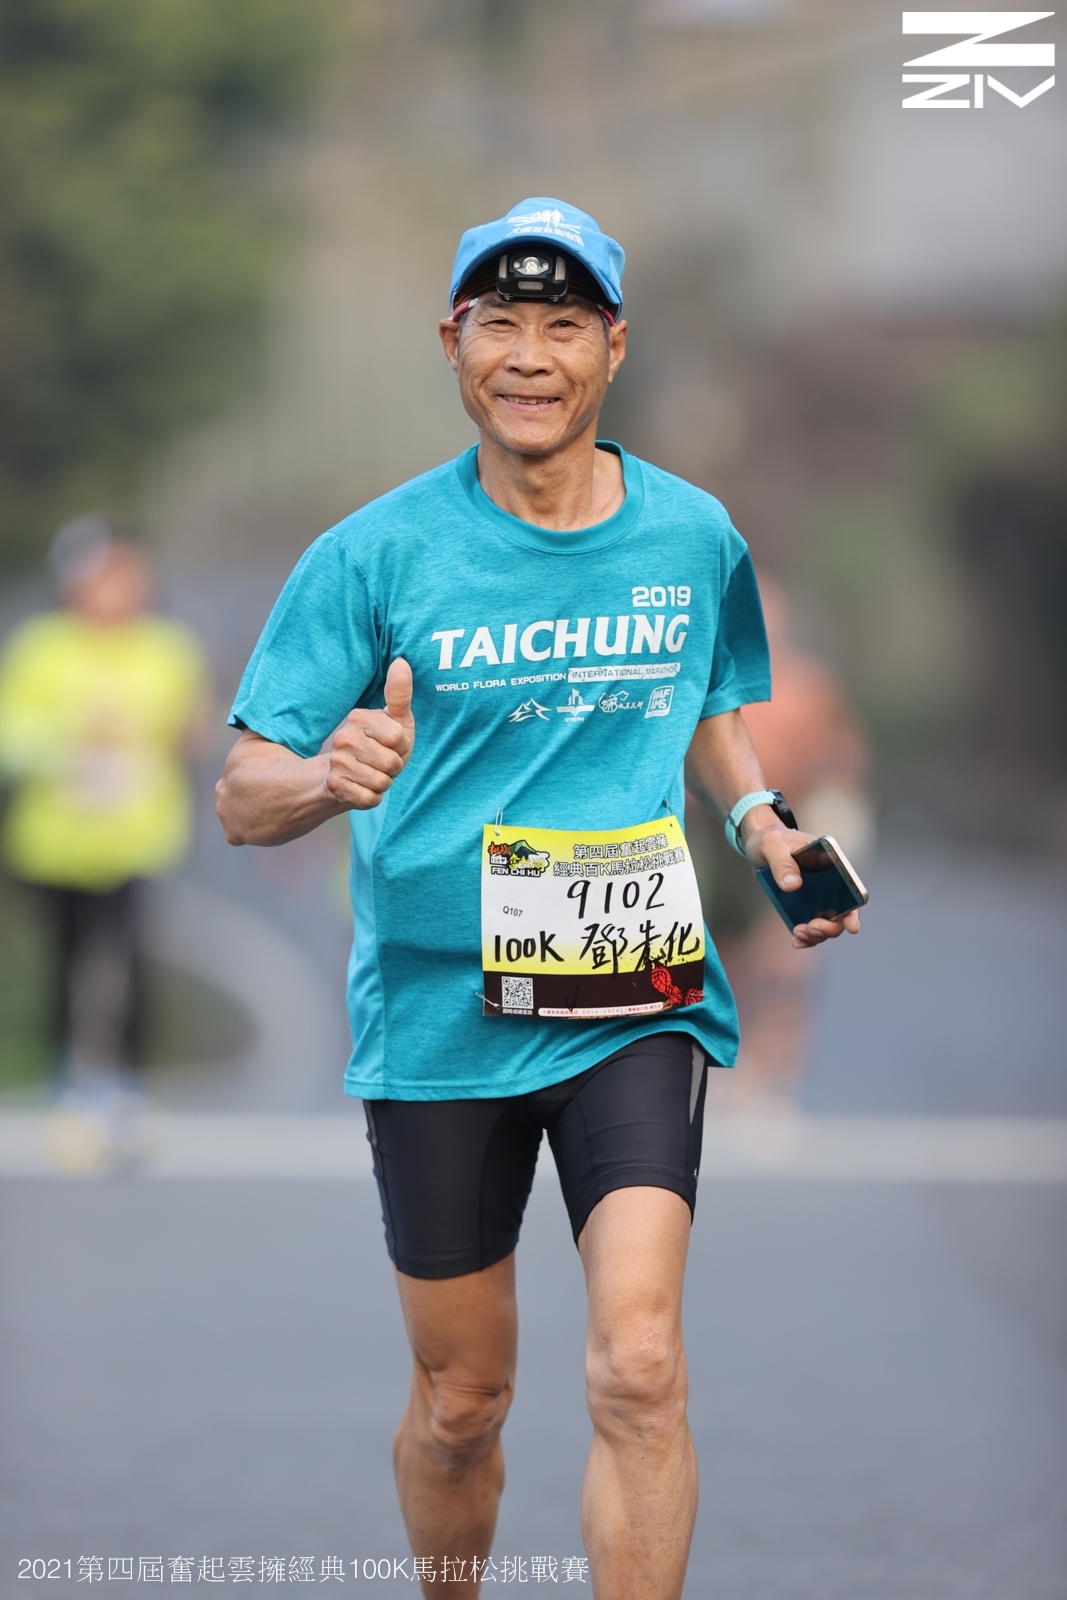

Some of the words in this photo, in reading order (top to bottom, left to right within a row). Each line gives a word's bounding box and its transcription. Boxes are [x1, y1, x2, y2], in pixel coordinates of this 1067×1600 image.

[632, 586, 691, 607] 2019
[431, 614, 690, 670] TAICHUNG
[435, 682, 469, 692] WORLD
[473, 679, 507, 689] FLORA
[511, 673, 567, 686] EXPOSITION
[572, 668, 643, 678] INTERNATIONAL
[573, 833, 668, 860] 第四屆奮起雲擁
[491, 866, 509, 875] FEN
[510, 868, 526, 876] CHI
[527, 869, 541, 877] HU
[553, 847, 686, 877] 經典百K馬拉松挑戰賽
[567, 872, 665, 919] 9102
[503, 906, 523, 917] Q107
[495, 931, 565, 963] 100K
